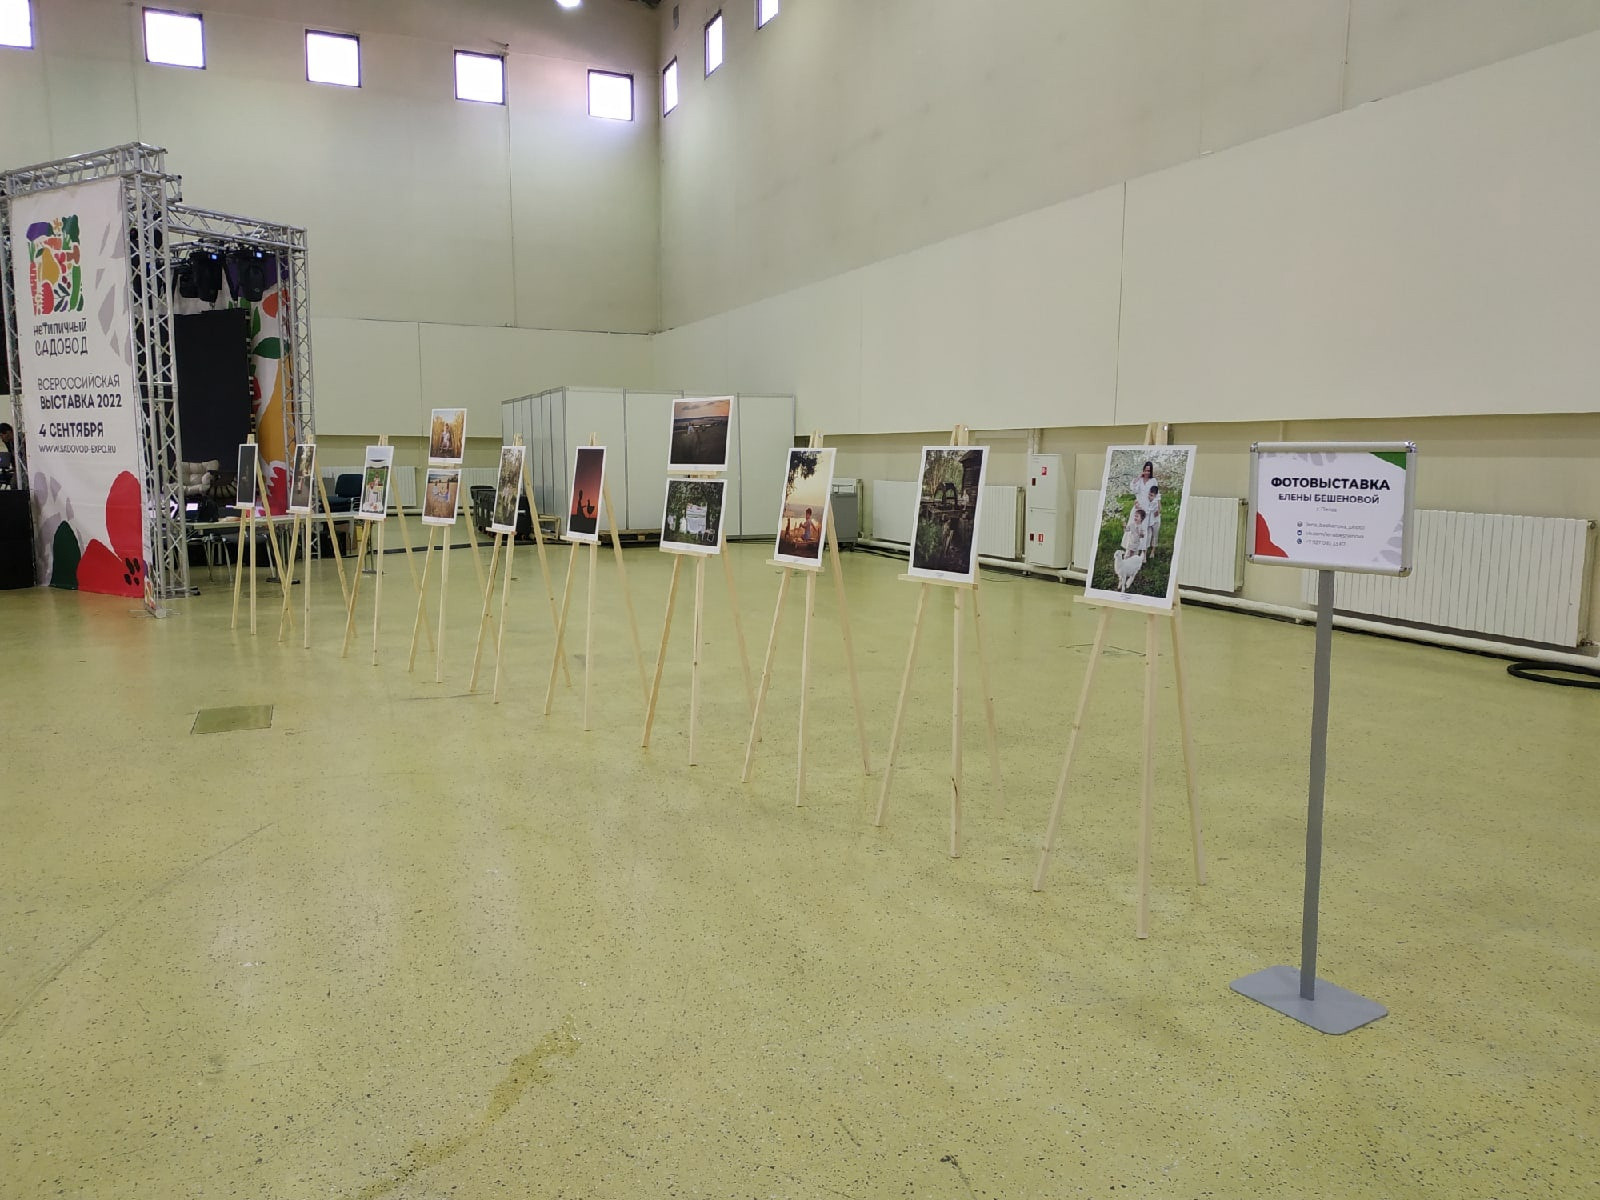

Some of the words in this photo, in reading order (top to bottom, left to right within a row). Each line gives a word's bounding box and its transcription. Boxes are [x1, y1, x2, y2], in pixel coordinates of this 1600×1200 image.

[35, 337, 88, 357] САДОВОД
[38, 374, 120, 390] ВСЕРОССИЙСКАЯ
[40, 394, 95, 410] ВЫСТАВКА
[97, 393, 122, 408] 2022
[39, 424, 47, 437] 4
[49, 422, 104, 438] СЕНТЯБРЯ
[1271, 477, 1391, 491] ФОТОВЫСТАВКА
[1278, 493, 1312, 502] ЕЛЕНЫ
[1314, 493, 1380, 505] БЕШЕНОВОЙ
